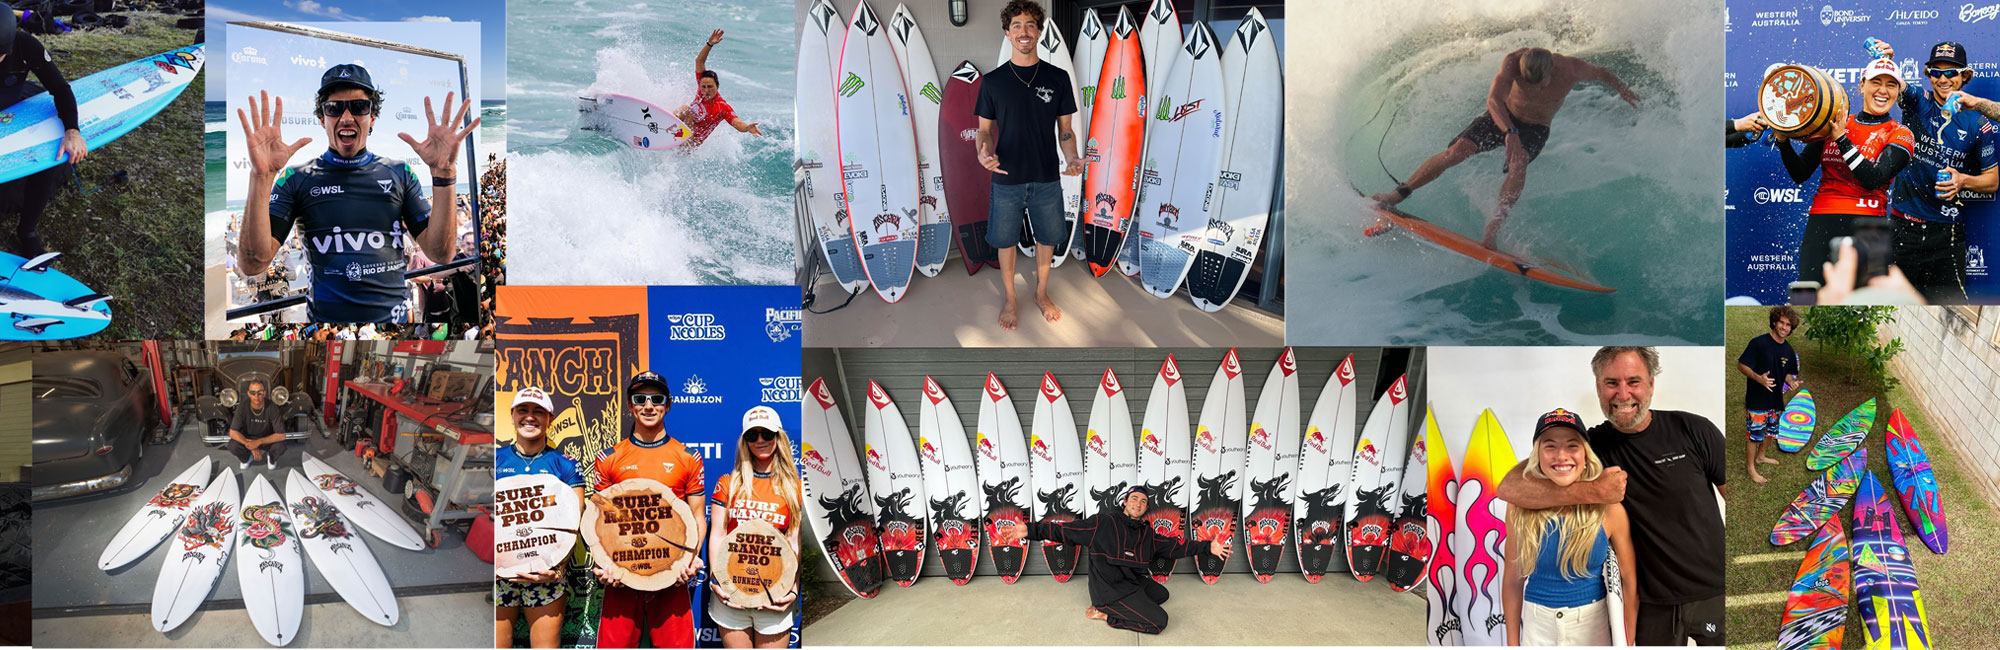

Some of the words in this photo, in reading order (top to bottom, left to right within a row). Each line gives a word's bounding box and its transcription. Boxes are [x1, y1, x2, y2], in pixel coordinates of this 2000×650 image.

[1885, 10, 1939, 20] SHISEIDO
[290, 55, 317, 67] vivo
[321, 186, 344, 194] WSL
[1770, 188, 1804, 203] WSL
[312, 226, 385, 254] vivo
[363, 267, 376, 275] RIO
[683, 313, 714, 327] CUP
[670, 325, 725, 340] NOODLES
[554, 417, 576, 434] WSL
[1250, 435, 1261, 446] Red
[1260, 440, 1272, 450] Bull
[802, 457, 817, 470] Red
[817, 465, 832, 477] Bull
[496, 485, 545, 503] SURF
[612, 494, 662, 509] SURF
[733, 499, 780, 511] SURF
[501, 509, 545, 527] PRO
[604, 506, 673, 524] RANCH
[618, 521, 660, 536] PRO
[496, 533, 558, 553] CHAMPION
[735, 533, 776, 545] SURF
[612, 547, 671, 561] CHAMPION
[727, 543, 782, 557] RANCH
[737, 553, 770, 566] PRO
[732, 576, 760, 587] RUNNER
